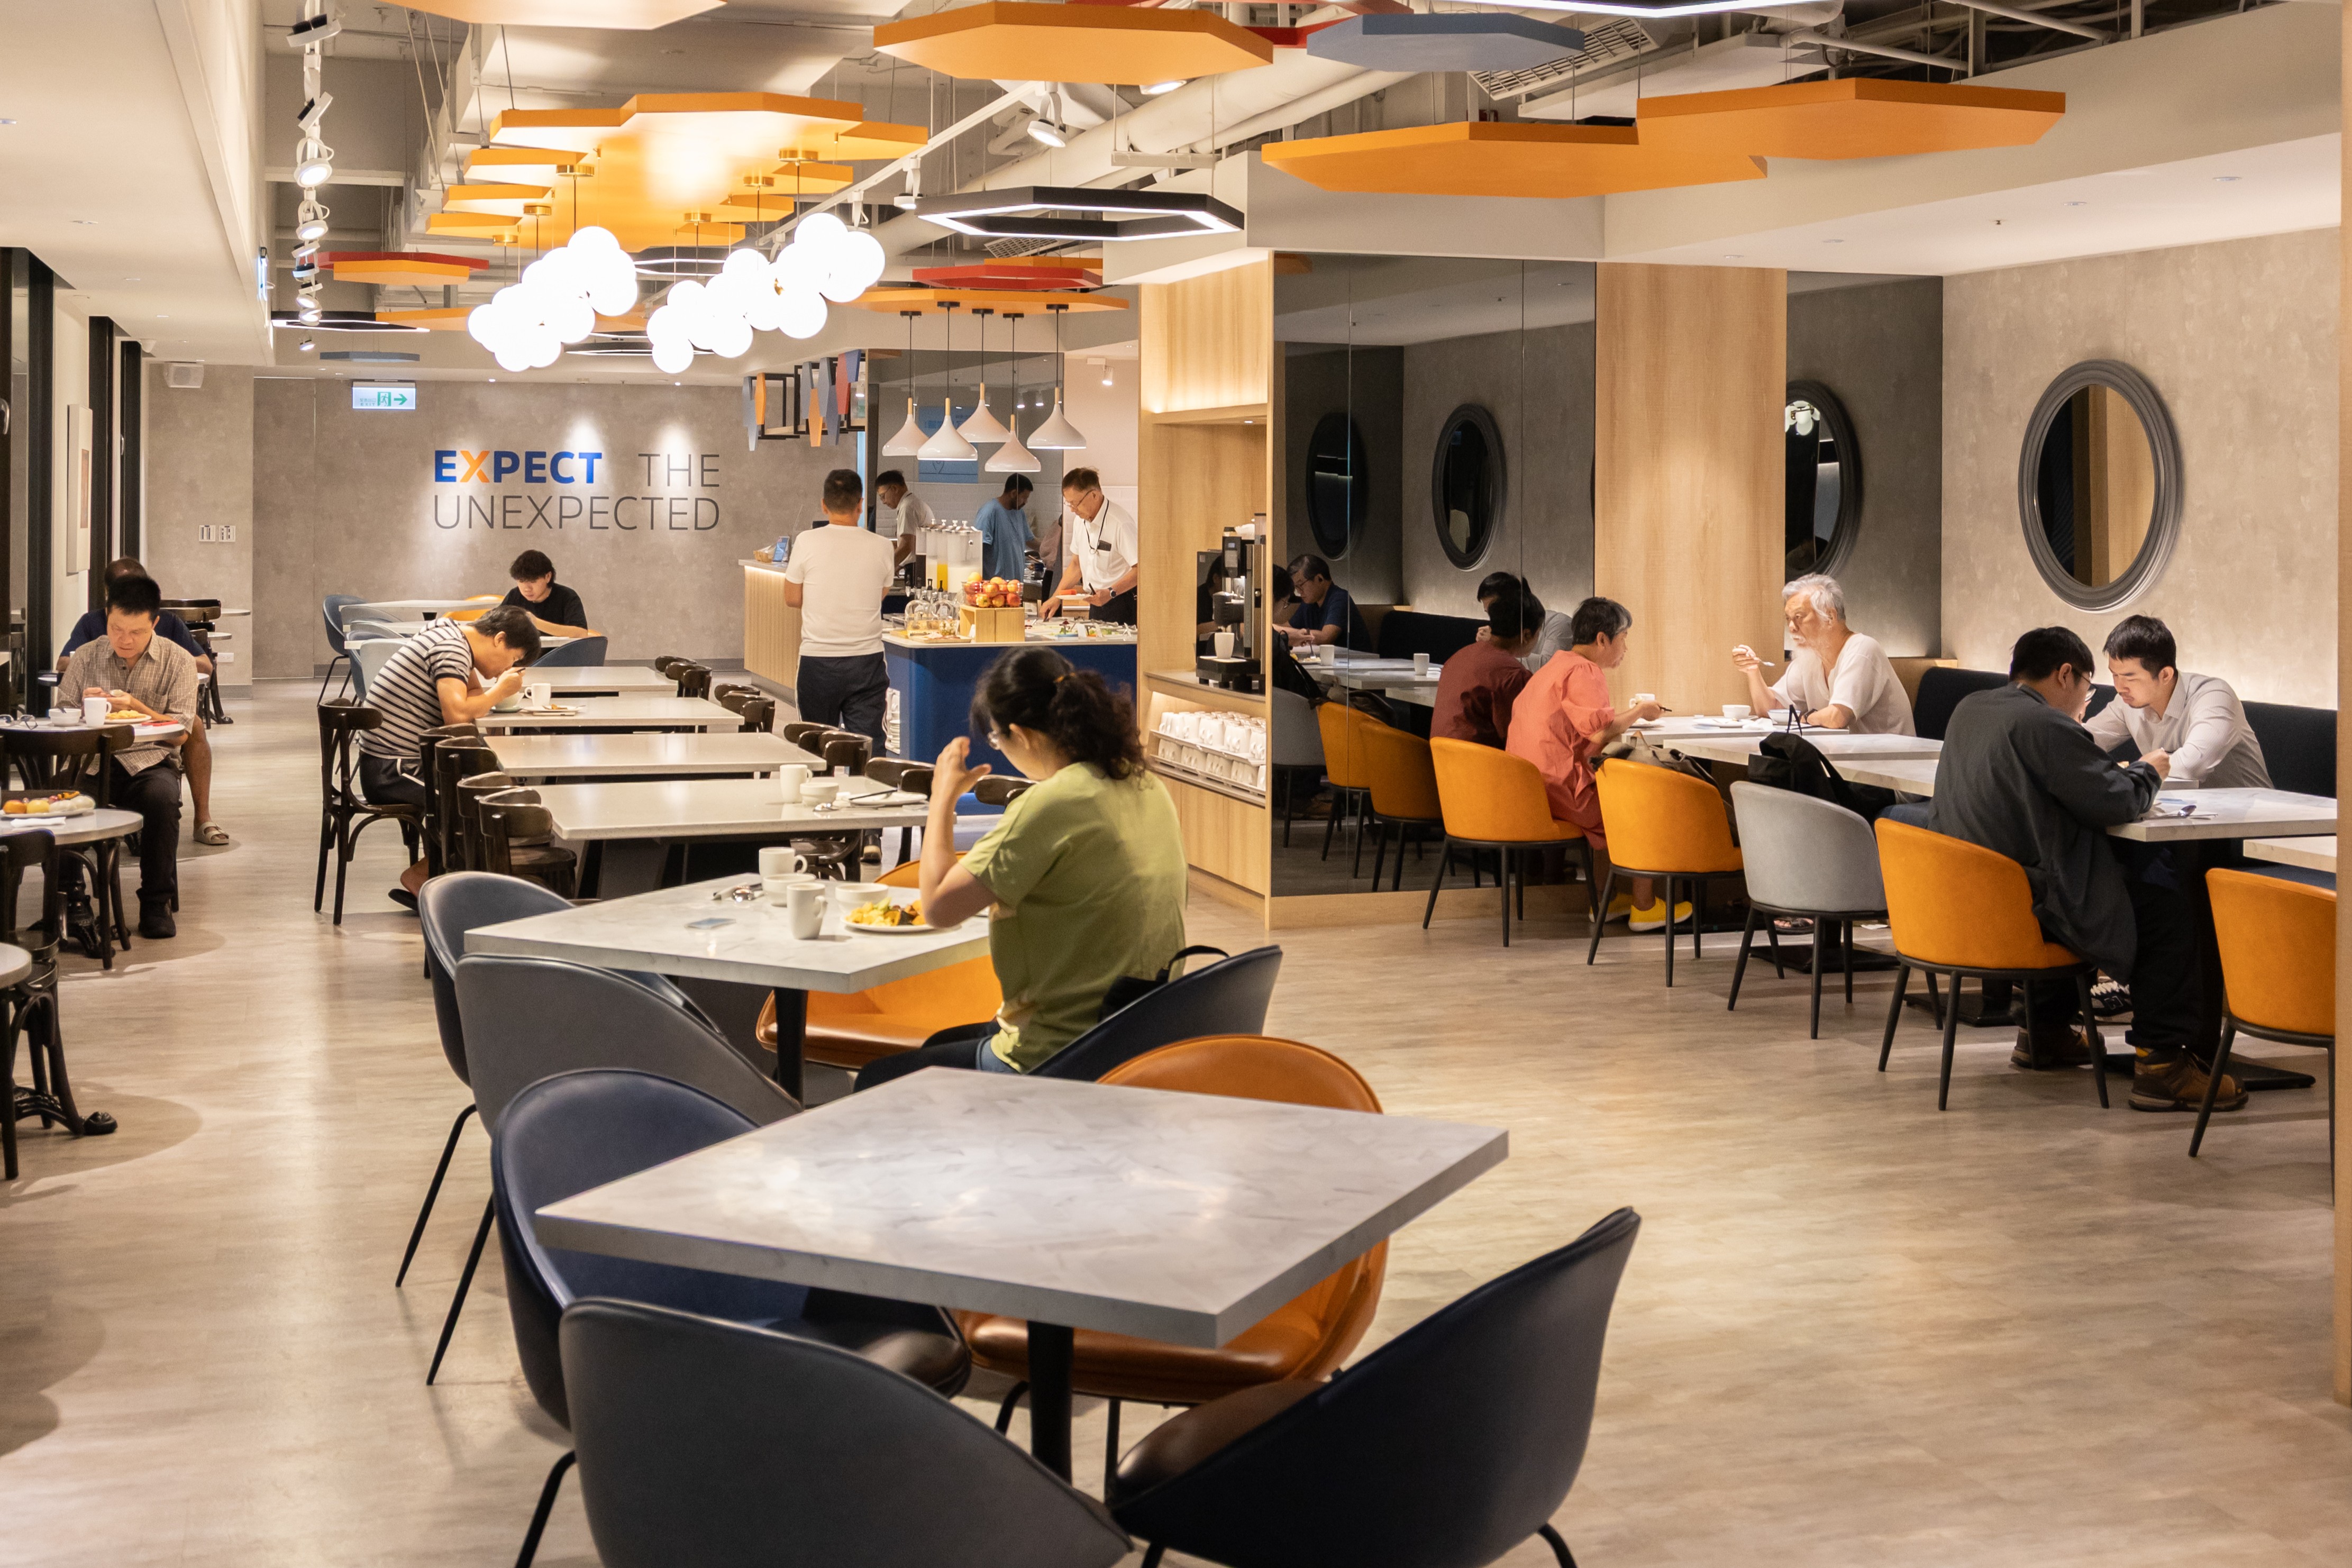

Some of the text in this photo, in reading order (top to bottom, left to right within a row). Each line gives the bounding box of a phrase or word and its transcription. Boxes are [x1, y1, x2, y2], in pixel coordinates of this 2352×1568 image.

[434, 450, 720, 487] EXPECT THE
[434, 495, 719, 531] UNEXPECTED
